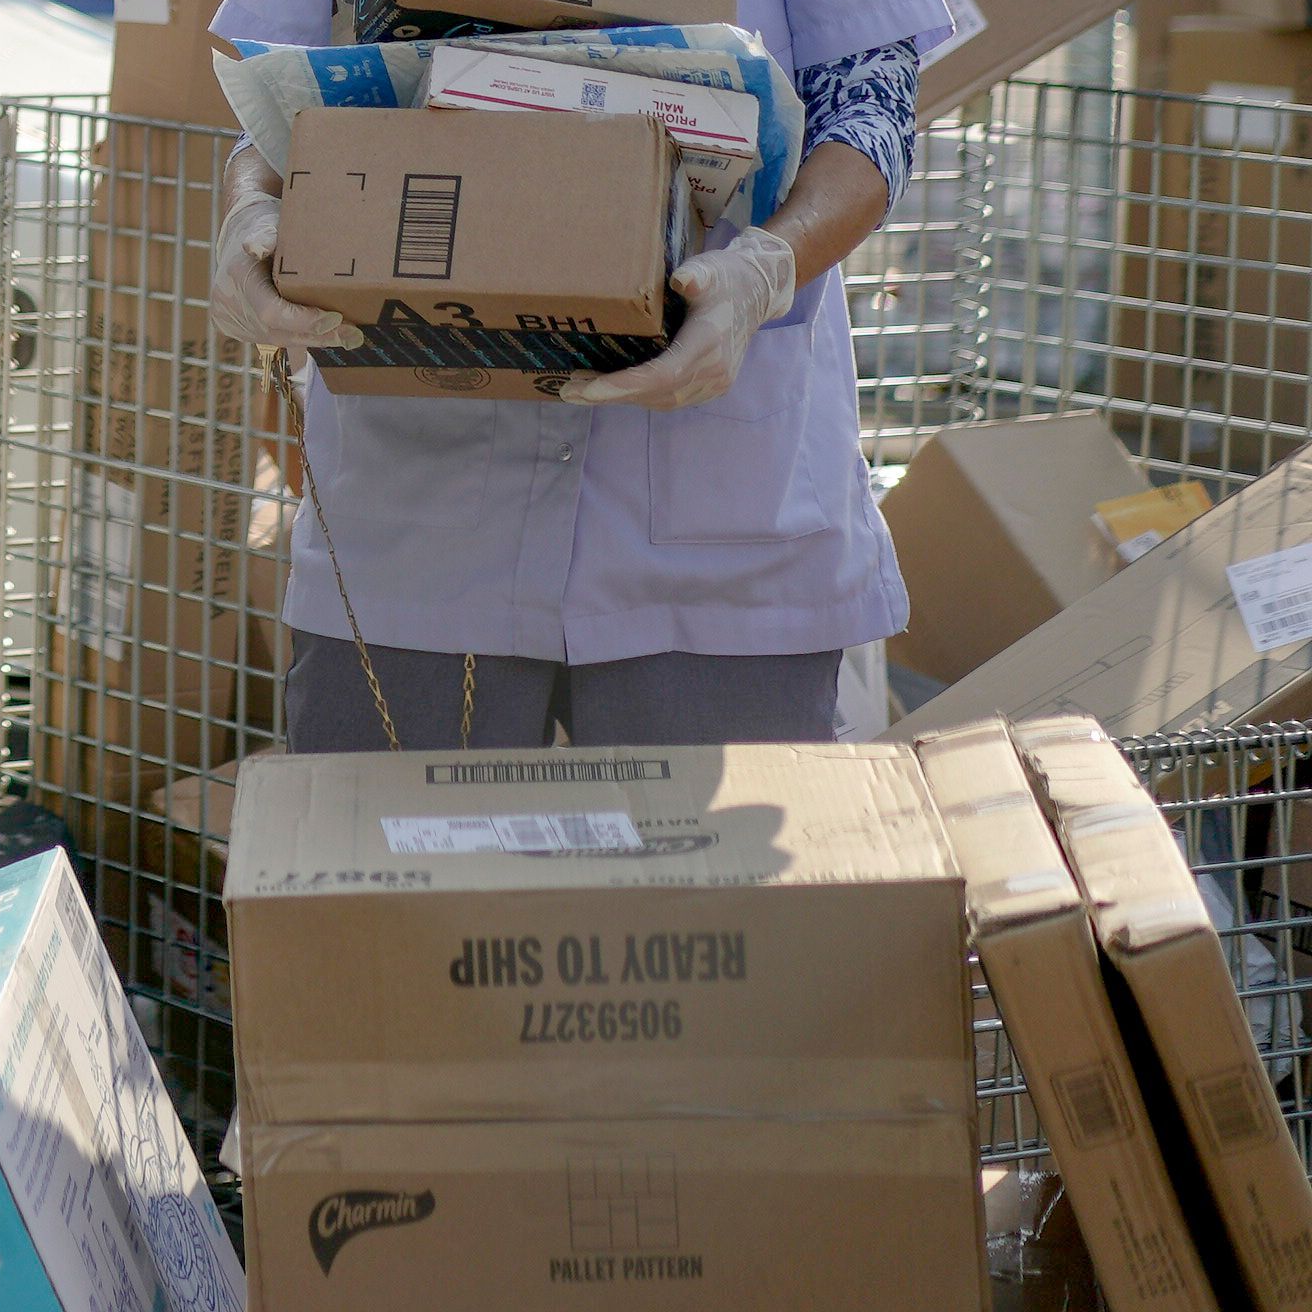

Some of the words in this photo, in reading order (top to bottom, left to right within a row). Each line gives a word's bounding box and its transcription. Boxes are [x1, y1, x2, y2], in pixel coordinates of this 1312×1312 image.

[653, 100, 684, 114] MAIL
[376, 298, 484, 329] A3
[515, 314, 599, 333] BH1
[449, 936, 544, 988] SHIP
[556, 935, 609, 985] TO
[622, 931, 746, 982] READY
[520, 999, 684, 1044] 90593277
[317, 1191, 416, 1239] Charmin
[549, 1258, 615, 1282] PALLET
[623, 1255, 703, 1280] PATTERN
